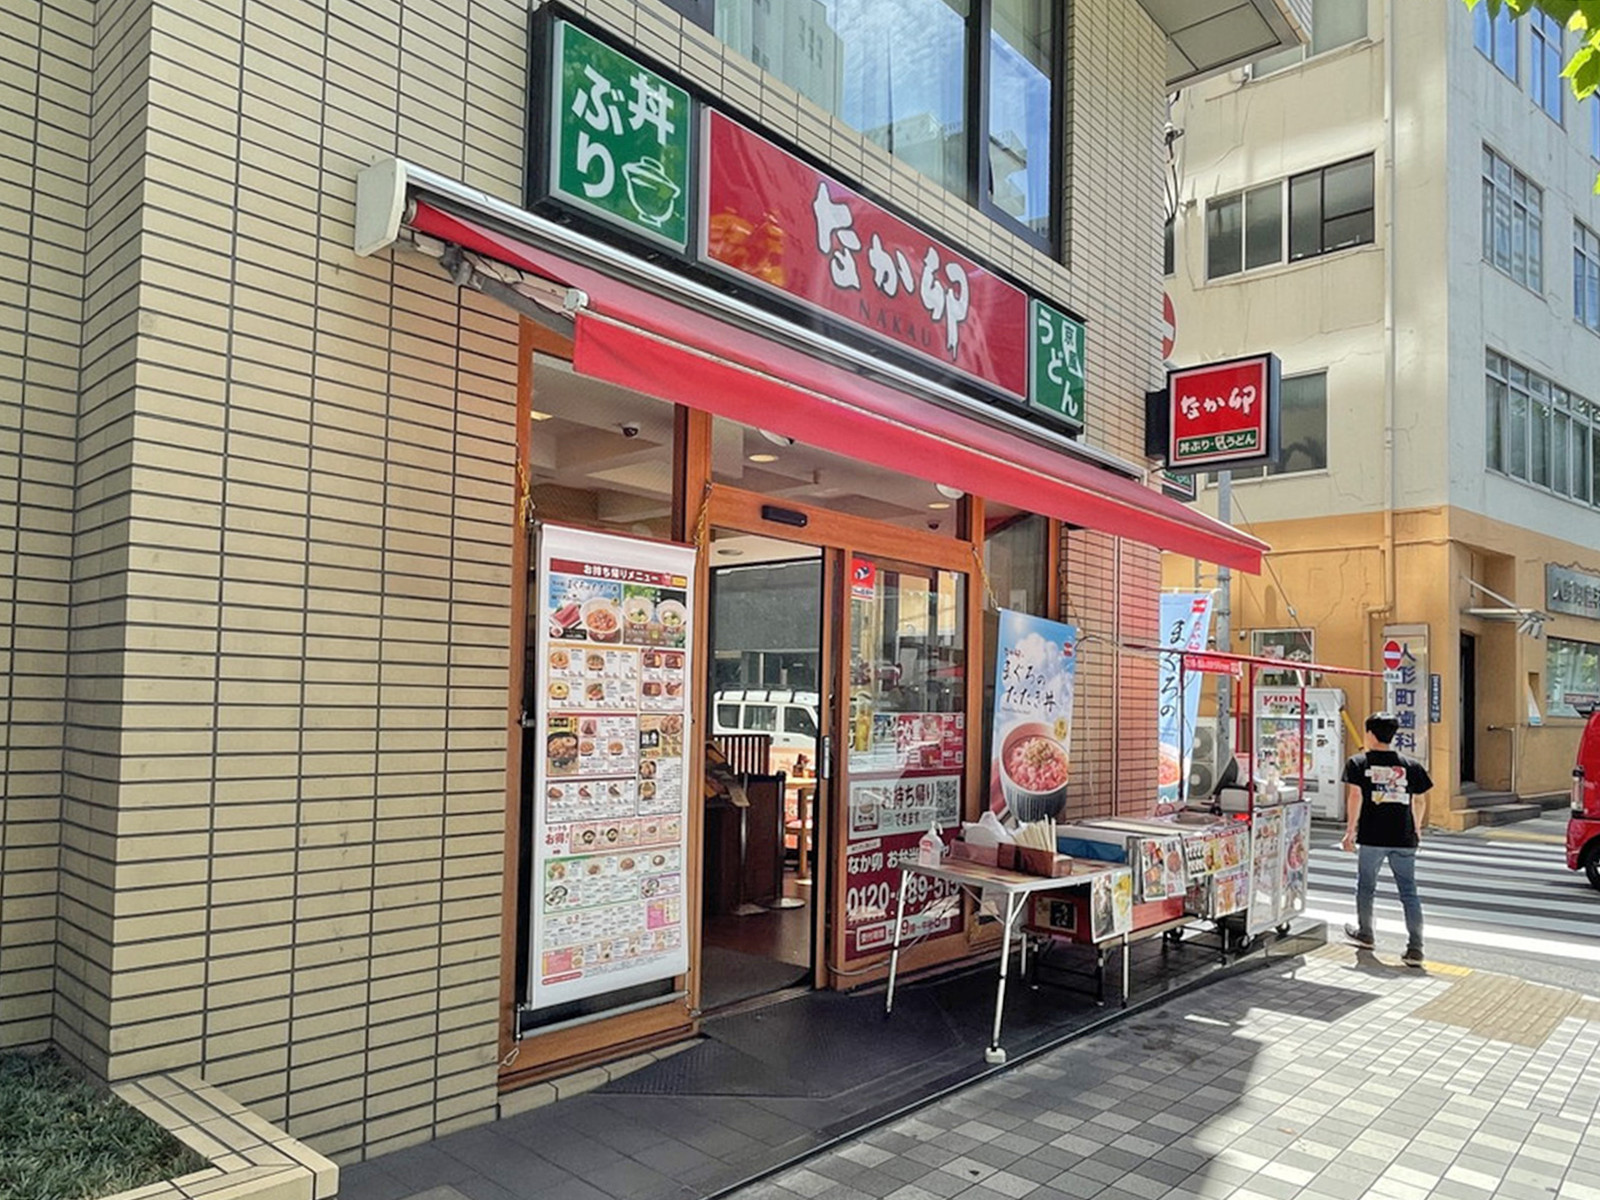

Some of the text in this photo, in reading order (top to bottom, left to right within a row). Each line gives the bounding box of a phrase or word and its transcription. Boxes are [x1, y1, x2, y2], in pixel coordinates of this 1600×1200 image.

[628, 72, 675, 146] 丼
[571, 64, 625, 198] ぶり
[812, 181, 970, 361] なか卯
[858, 300, 932, 346] NAKAU
[1038, 308, 1078, 417] うどん
[1180, 385, 1257, 420] なか卯
[583, 564, 659, 583] お持ち帰りメニュー
[1003, 660, 1046, 686] まぐろの
[1006, 686, 1056, 712] たたき丼
[1394, 642, 1417, 752] 人形町歯科
[881, 783, 935, 810] お持ち帰り
[894, 811, 921, 827] できます
[848, 852, 883, 875] なか卯
